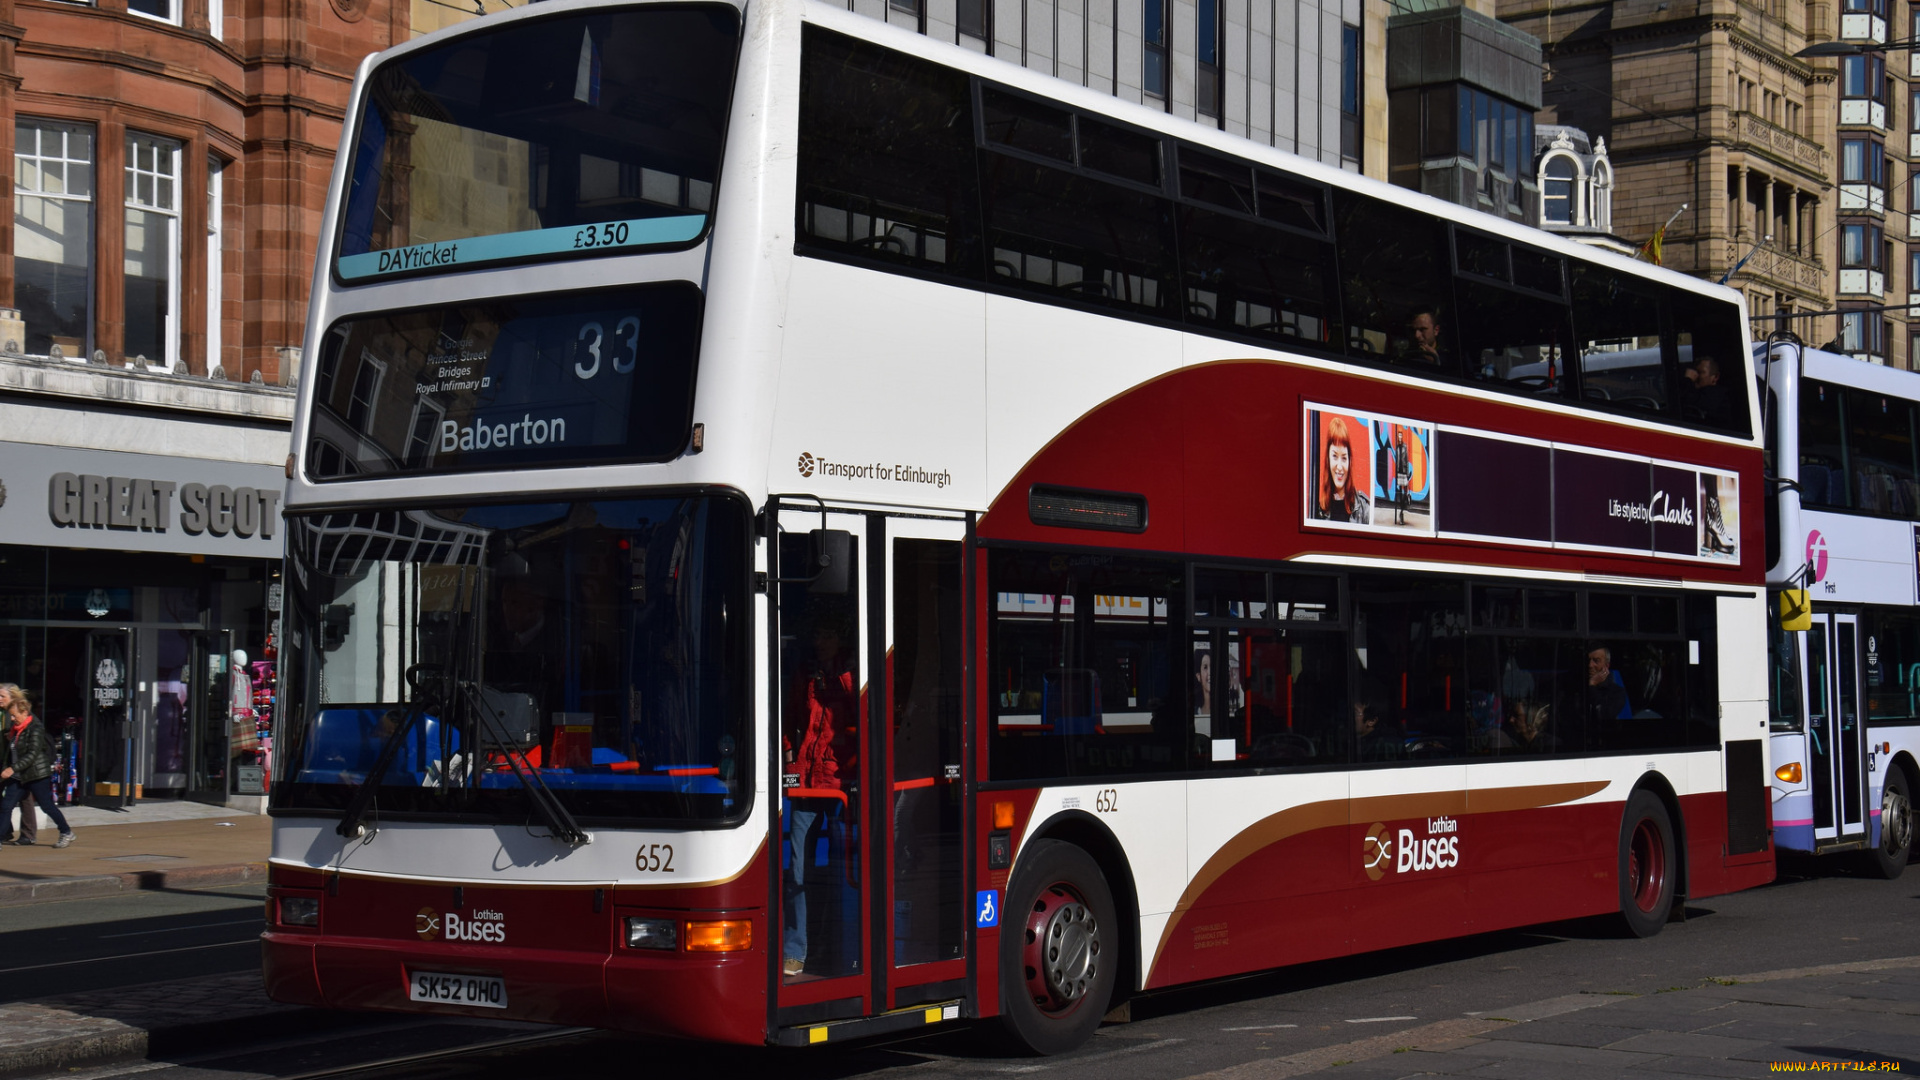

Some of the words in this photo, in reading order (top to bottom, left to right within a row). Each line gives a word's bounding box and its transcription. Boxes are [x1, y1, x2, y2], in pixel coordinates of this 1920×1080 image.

[573, 222, 629, 249] £3.50
[378, 243, 458, 272] DAYticket
[426, 353, 458, 366] Princes
[460, 349, 488, 362] Street
[574, 315, 641, 380] 33
[438, 366, 472, 379] Bridges
[415, 381, 439, 395] Royal
[440, 379, 480, 391] Infirmary
[440, 413, 566, 453] Baberton
[816, 457, 874, 481] Transport
[875, 463, 893, 480] for
[895, 465, 951, 489] Edinburgh
[49, 472, 176, 533] GREAT
[180, 482, 281, 540] SCOT
[1608, 498, 1621, 517] Life
[1622, 501, 1641, 523] styled
[1641, 503, 1650, 524] by
[1648, 489, 1694, 526] Clarks
[1824, 580, 1837, 594] First
[1096, 788, 1118, 813] 652
[1427, 815, 1457, 834] Lothian
[635, 844, 675, 873] 652
[1396, 828, 1459, 873] Buses
[444, 913, 506, 943] Buses
[473, 908, 504, 921] Lothian
[418, 975, 462, 1001] SK52
